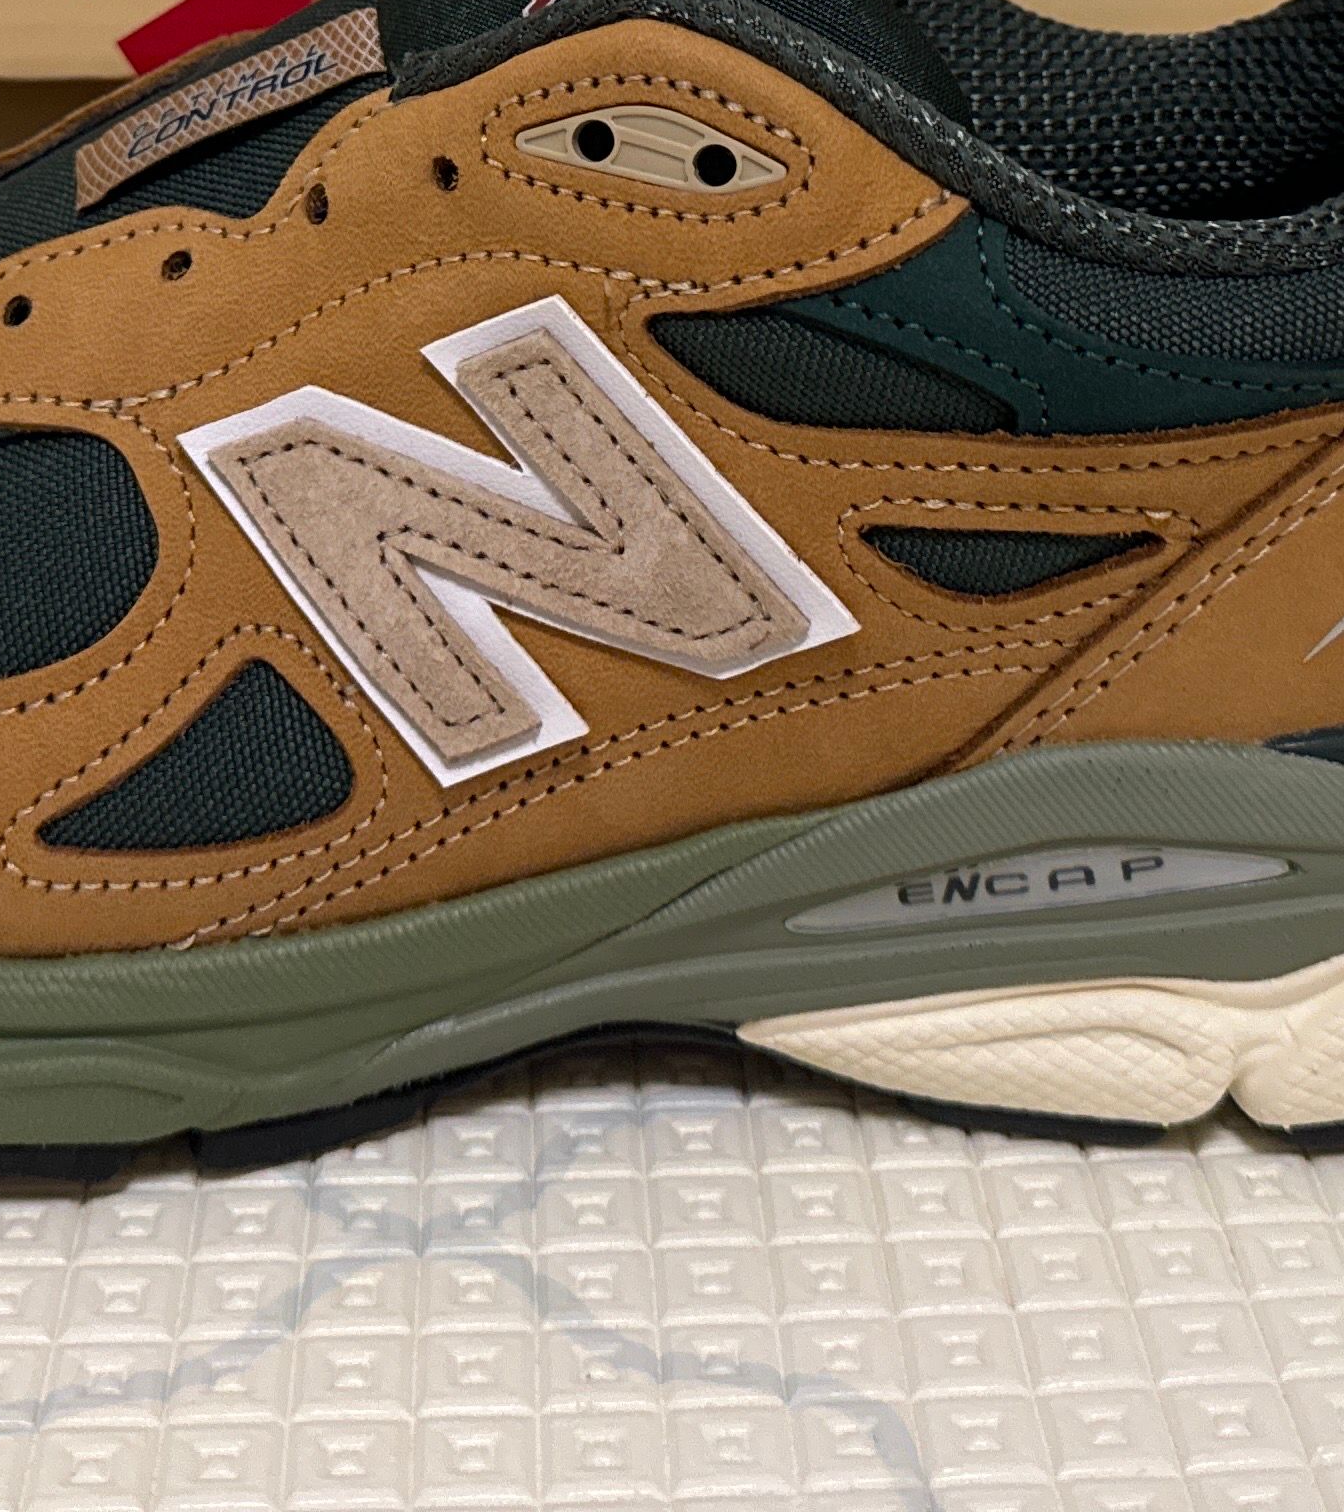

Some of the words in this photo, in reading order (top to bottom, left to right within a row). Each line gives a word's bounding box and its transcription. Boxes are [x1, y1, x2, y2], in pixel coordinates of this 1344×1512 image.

[127, 51, 338, 159] CONTROL
[176, 294, 861, 788] N
[896, 854, 1166, 907] ENCAP
